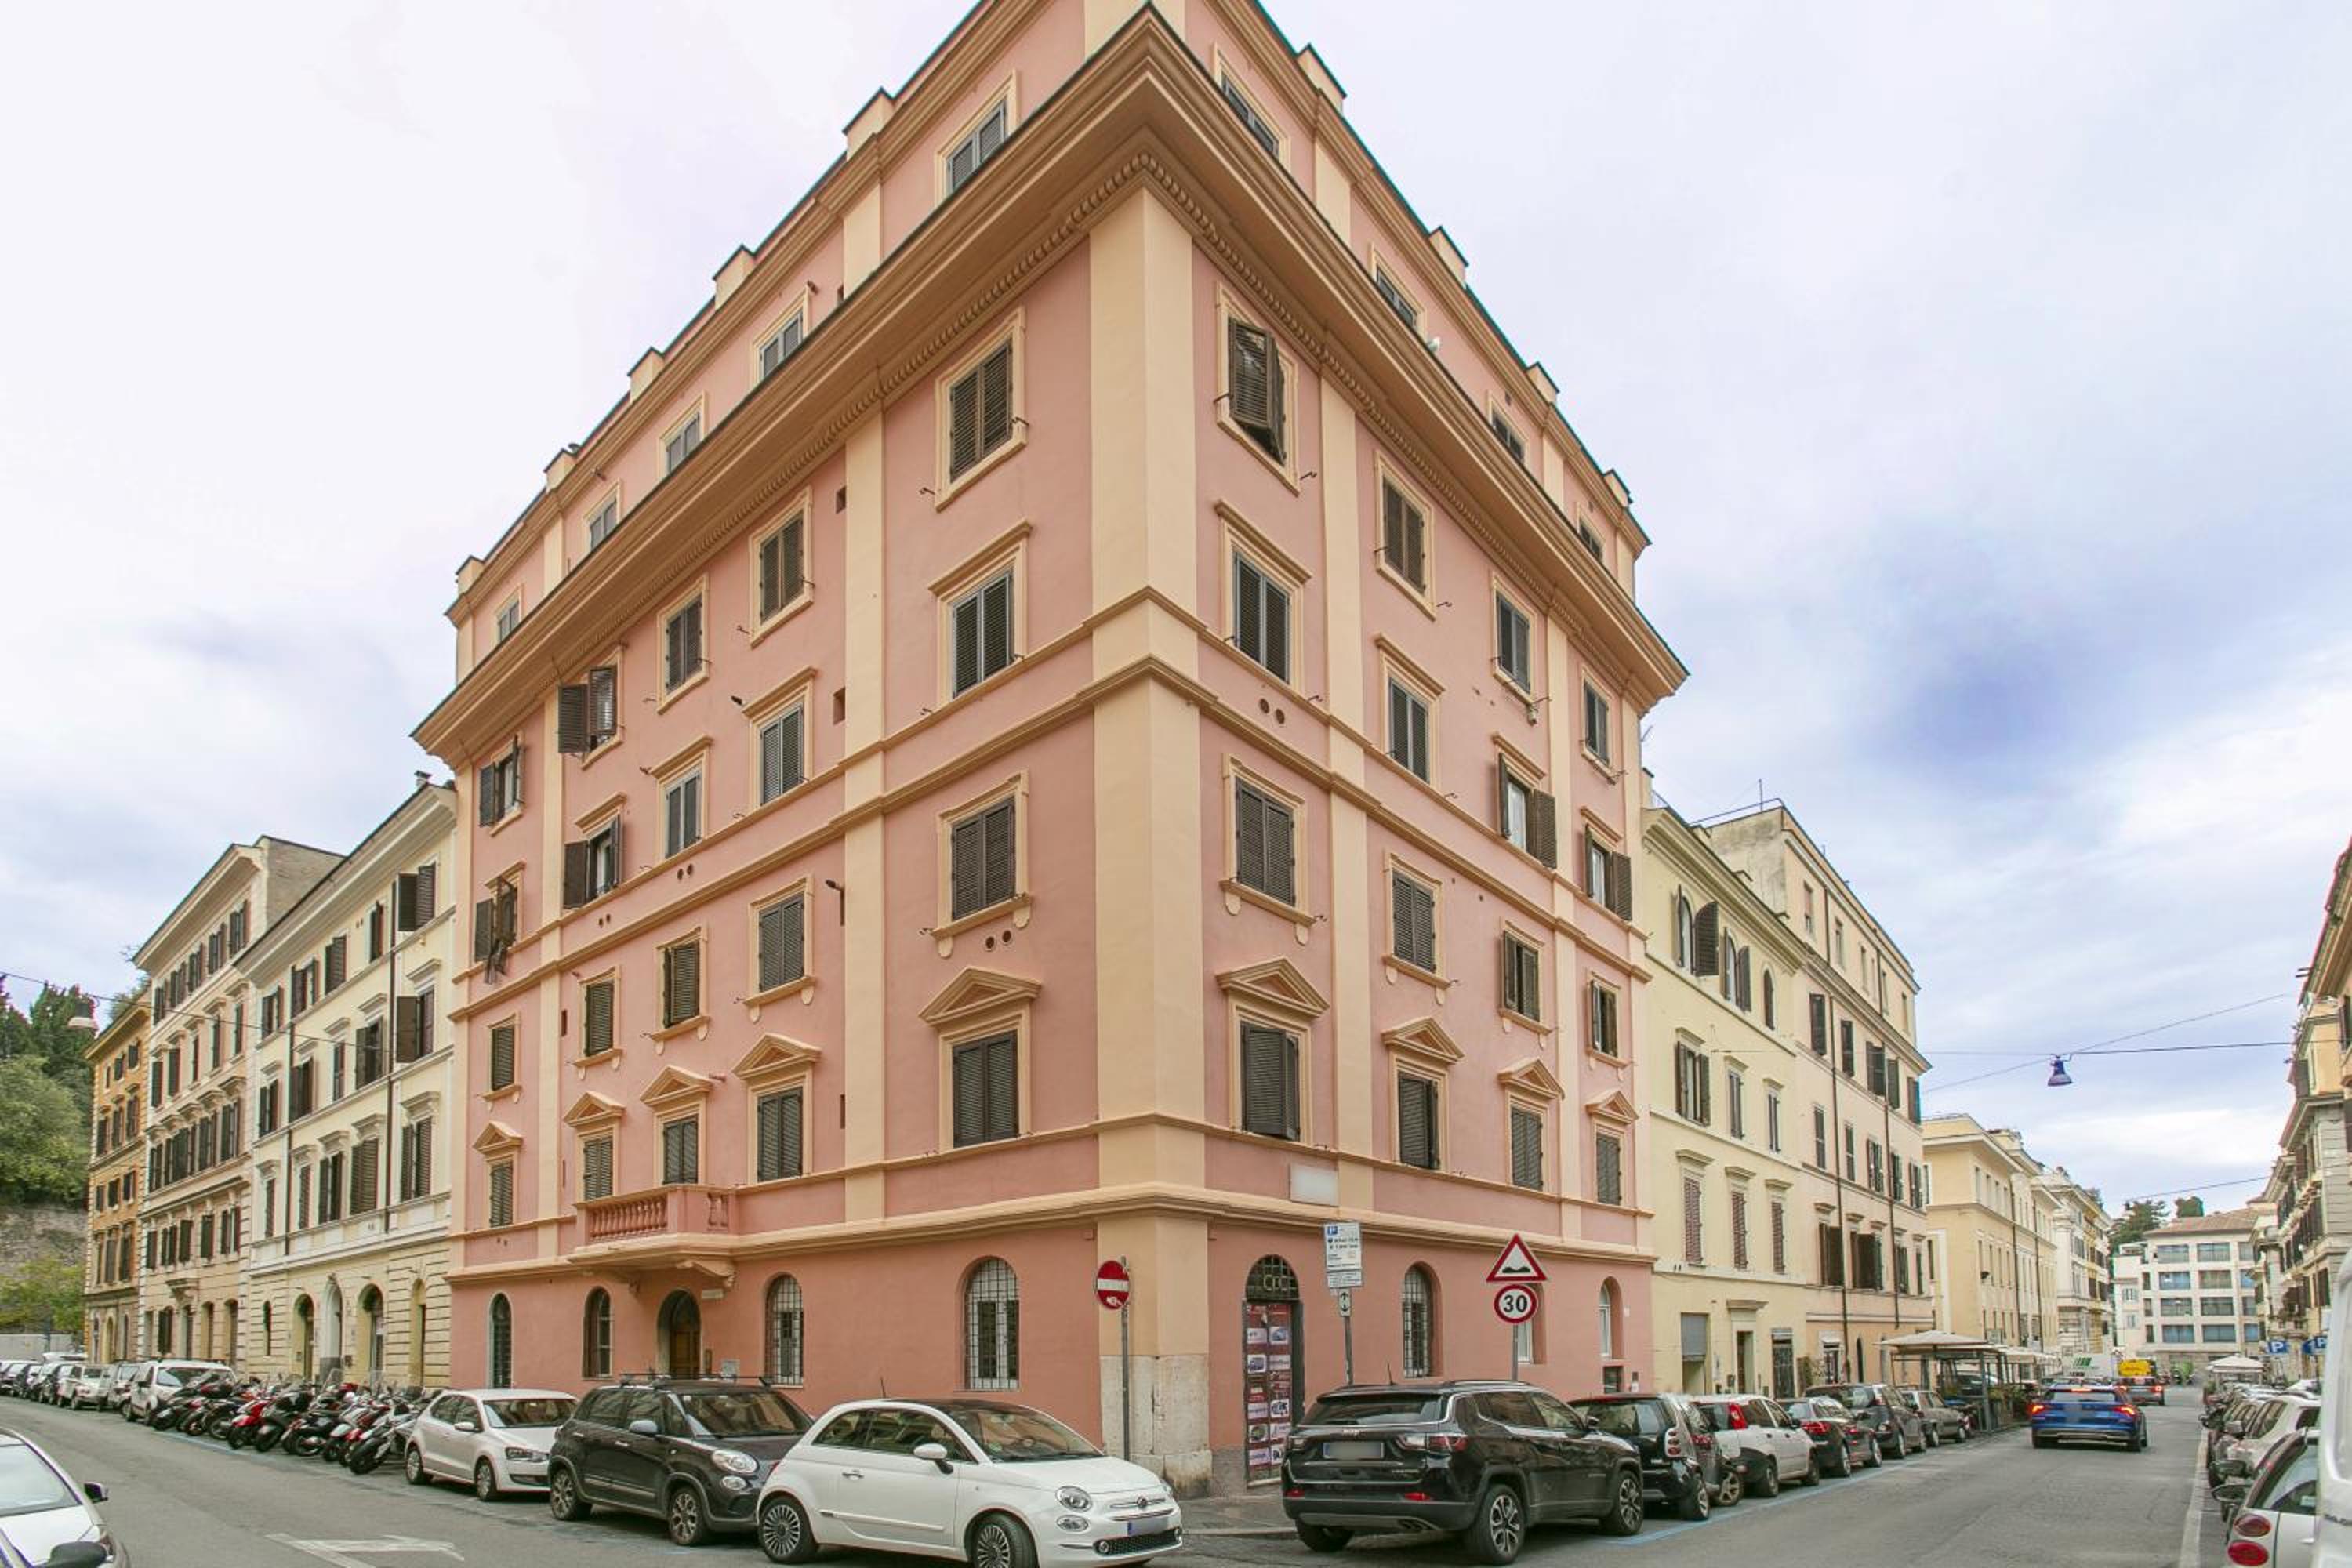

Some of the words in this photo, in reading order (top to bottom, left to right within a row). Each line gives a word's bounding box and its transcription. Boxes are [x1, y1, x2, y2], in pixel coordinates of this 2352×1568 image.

[1503, 1294, 1527, 1313] 30
[2270, 1341, 2284, 1352] P
[2317, 1337, 2327, 1347] P
